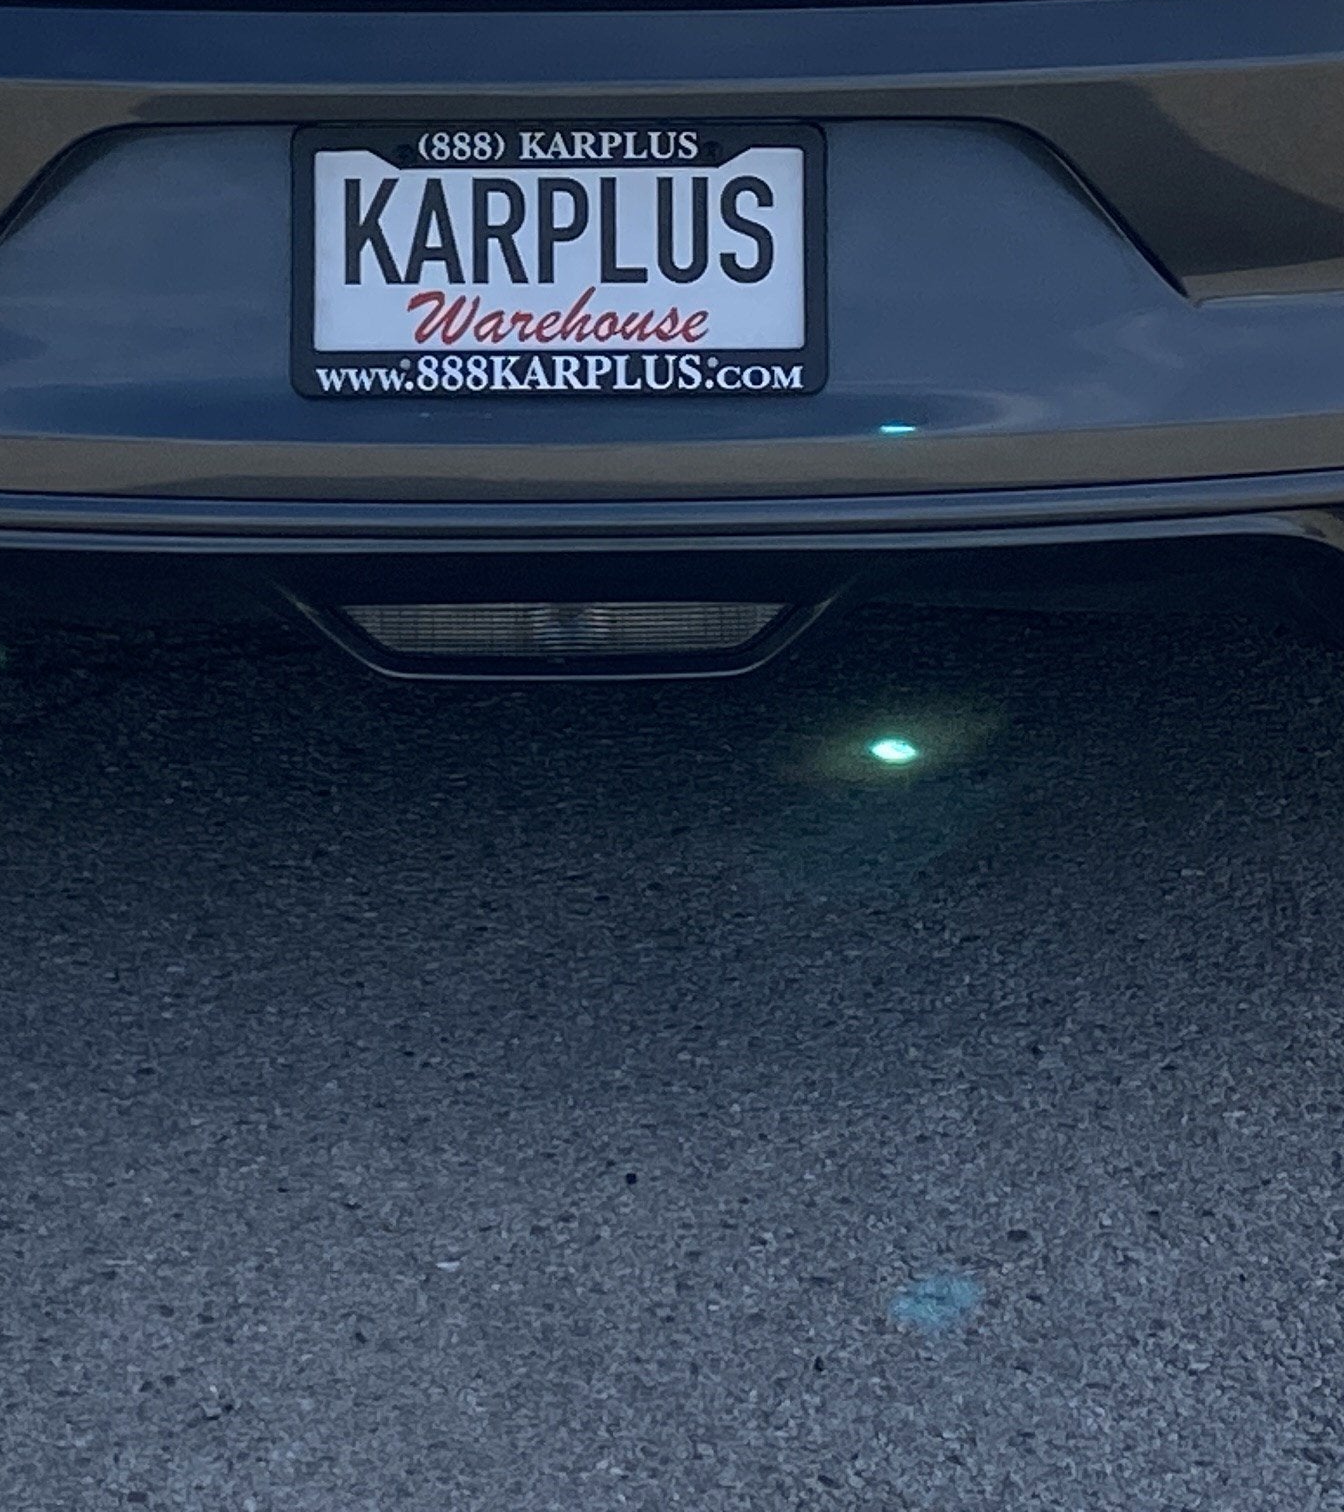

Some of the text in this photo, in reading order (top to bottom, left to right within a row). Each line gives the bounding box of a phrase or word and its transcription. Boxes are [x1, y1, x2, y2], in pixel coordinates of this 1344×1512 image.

[417, 131, 699, 161] (888) KARPLUS
[343, 176, 776, 285] KARPLUS
[407, 286, 710, 345] Warehouse
